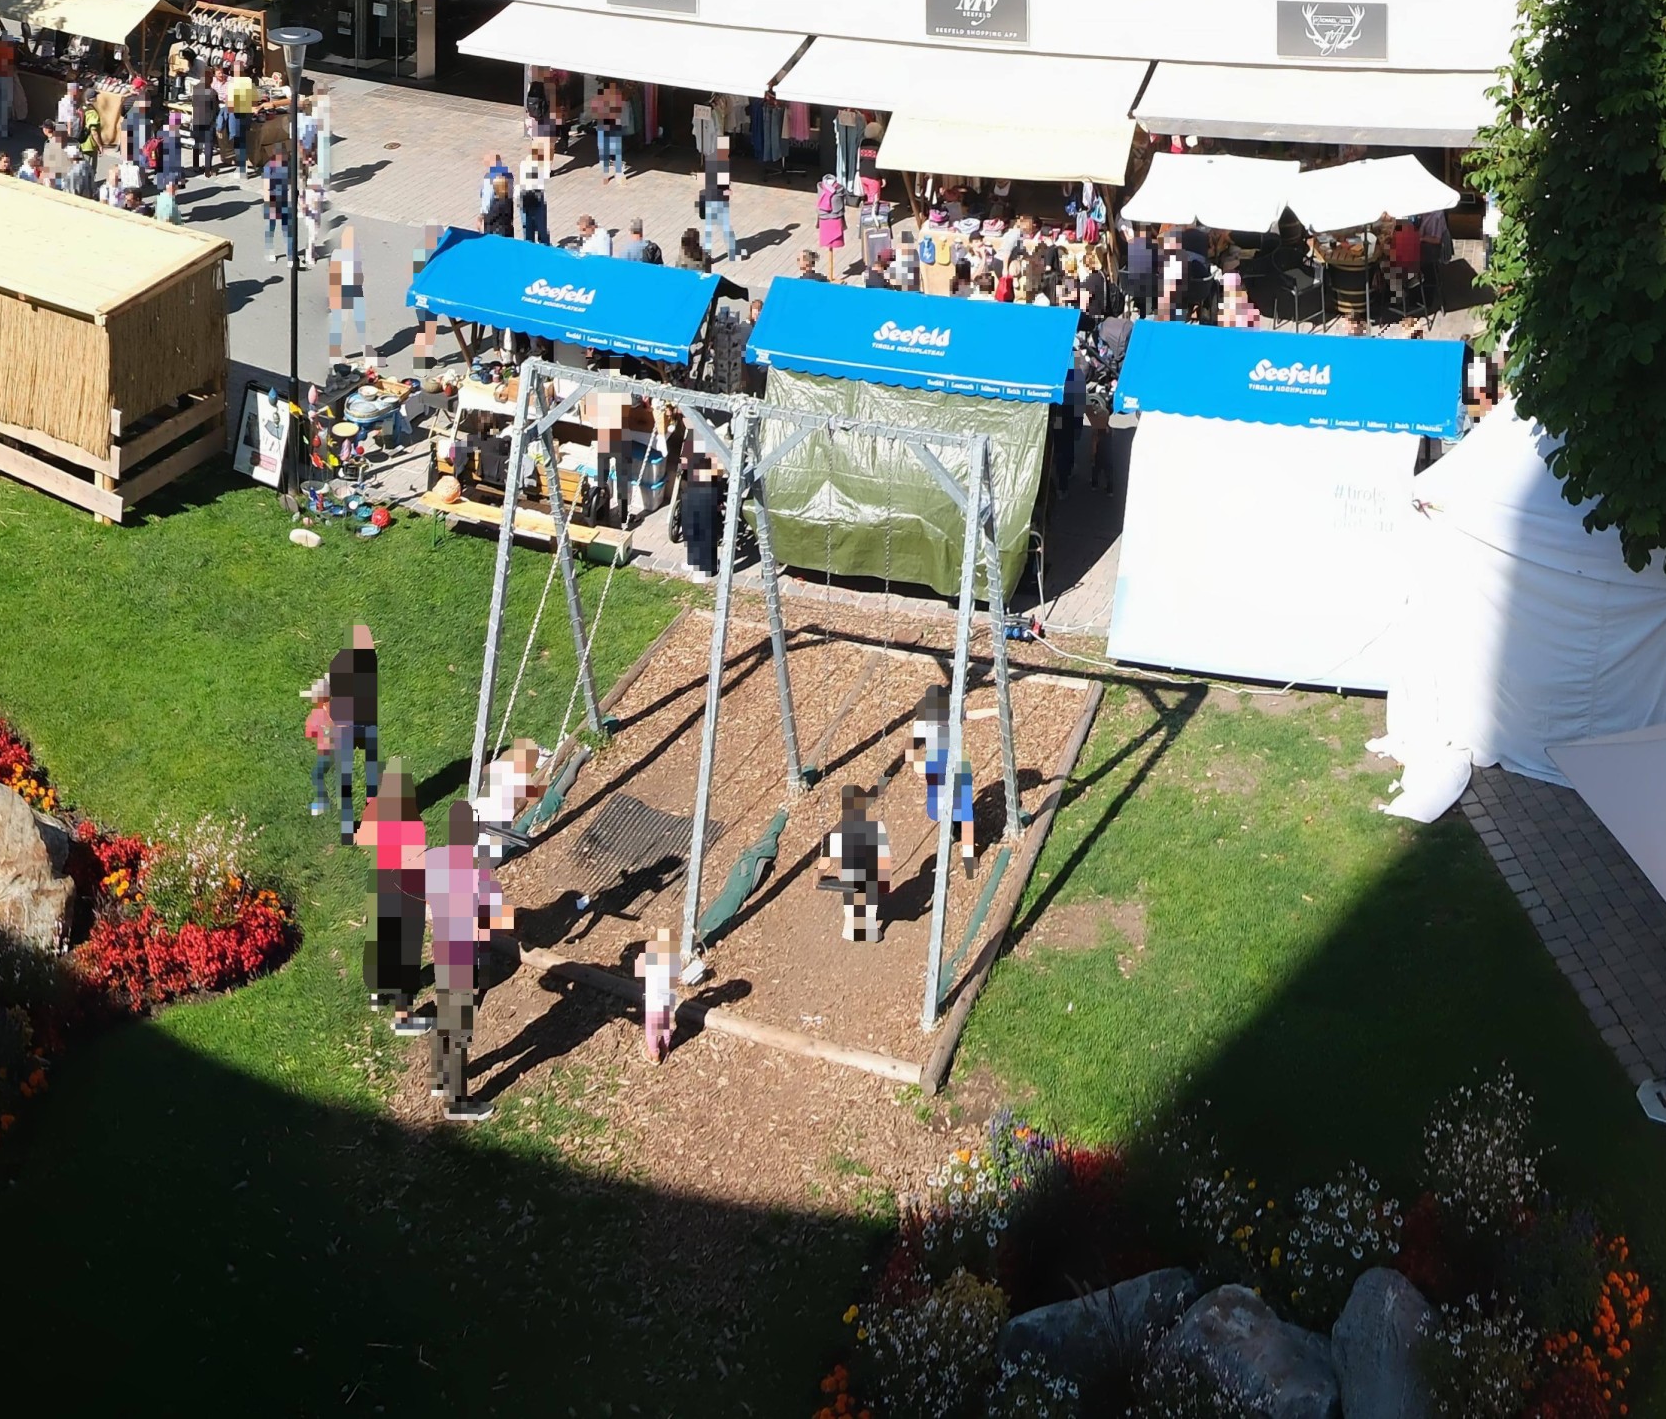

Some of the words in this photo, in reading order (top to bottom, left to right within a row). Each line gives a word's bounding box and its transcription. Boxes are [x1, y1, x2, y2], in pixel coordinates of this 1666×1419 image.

[935, 27, 965, 36] SEEFELD
[523, 278, 596, 306] Seefeld
[873, 320, 951, 347] Seefeld
[1249, 359, 1330, 385] Seefeld
